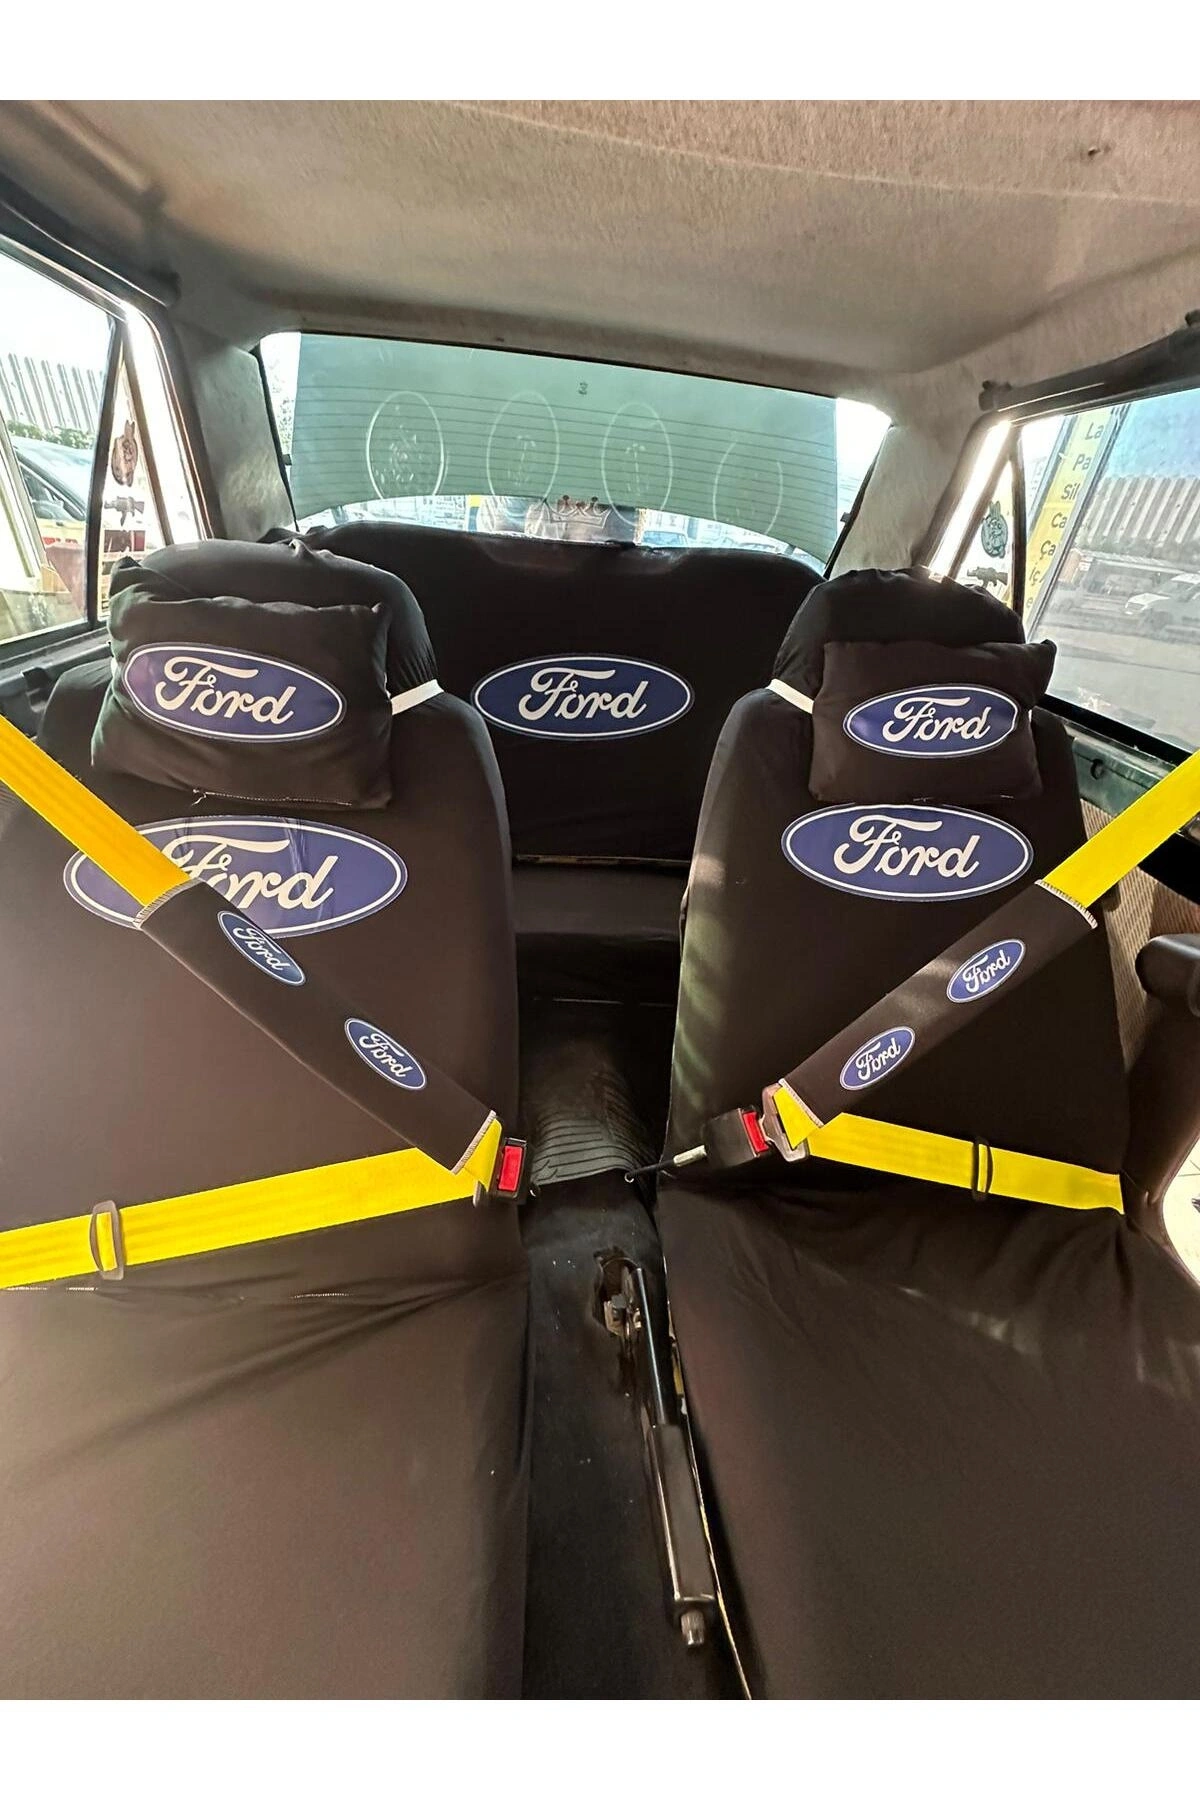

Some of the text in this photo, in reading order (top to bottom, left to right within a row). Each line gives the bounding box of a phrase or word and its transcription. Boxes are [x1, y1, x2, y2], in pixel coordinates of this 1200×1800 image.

[155, 656, 297, 725] Ford
[518, 667, 649, 721] Ford
[882, 696, 992, 743] Ford
[834, 814, 981, 878] Ford
[233, 927, 291, 971] Ford
[962, 949, 1011, 993] Ford
[359, 1033, 413, 1078] Ford
[855, 1037, 901, 1081] Ford
